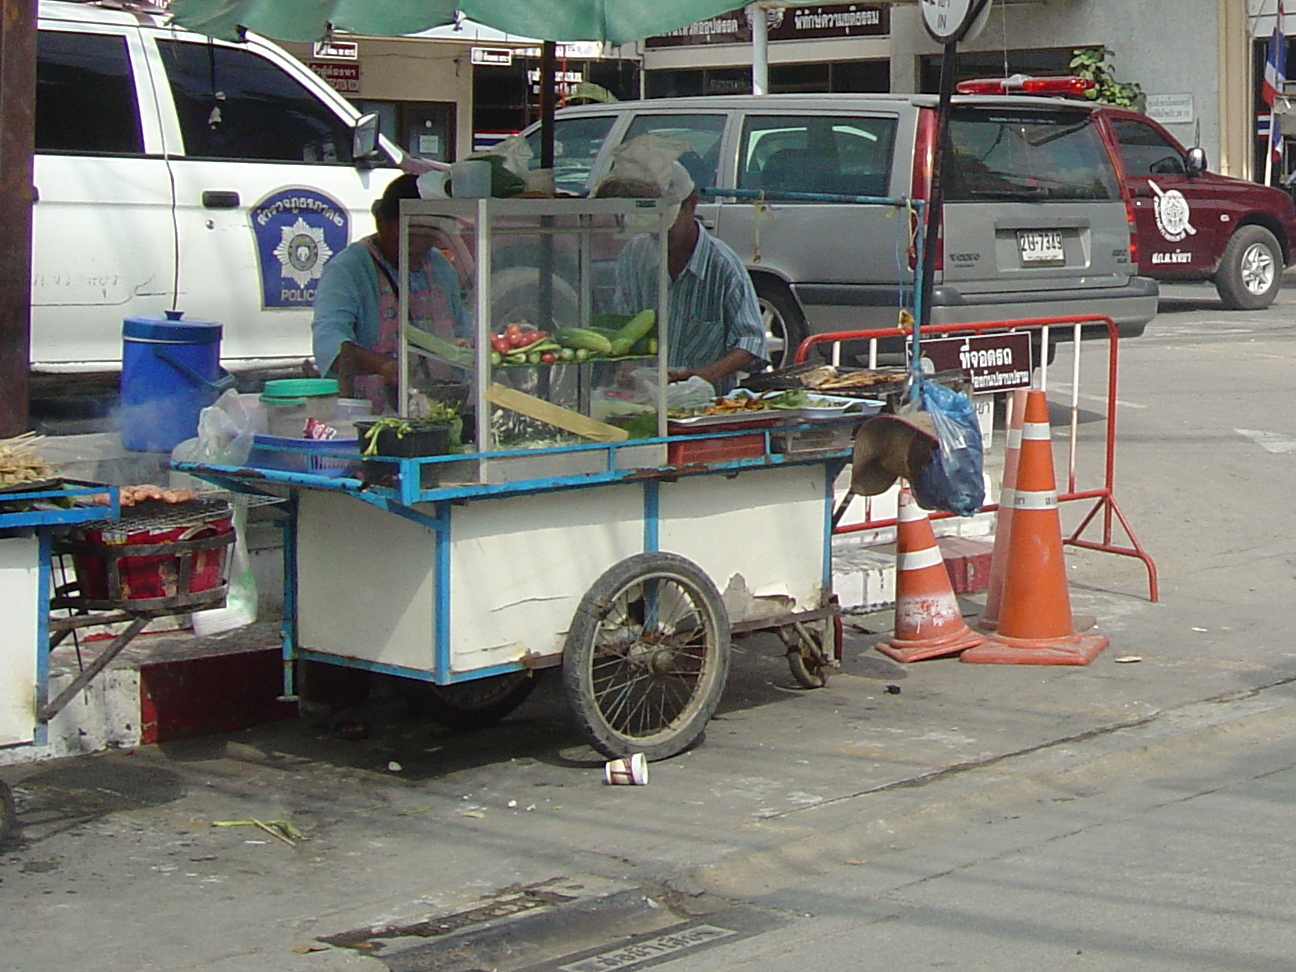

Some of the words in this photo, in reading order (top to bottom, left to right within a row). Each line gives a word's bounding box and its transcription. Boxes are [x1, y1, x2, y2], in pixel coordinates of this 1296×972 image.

[281, 289, 317, 302] POLIC
[959, 338, 1012, 369] ที่จอดรถ
